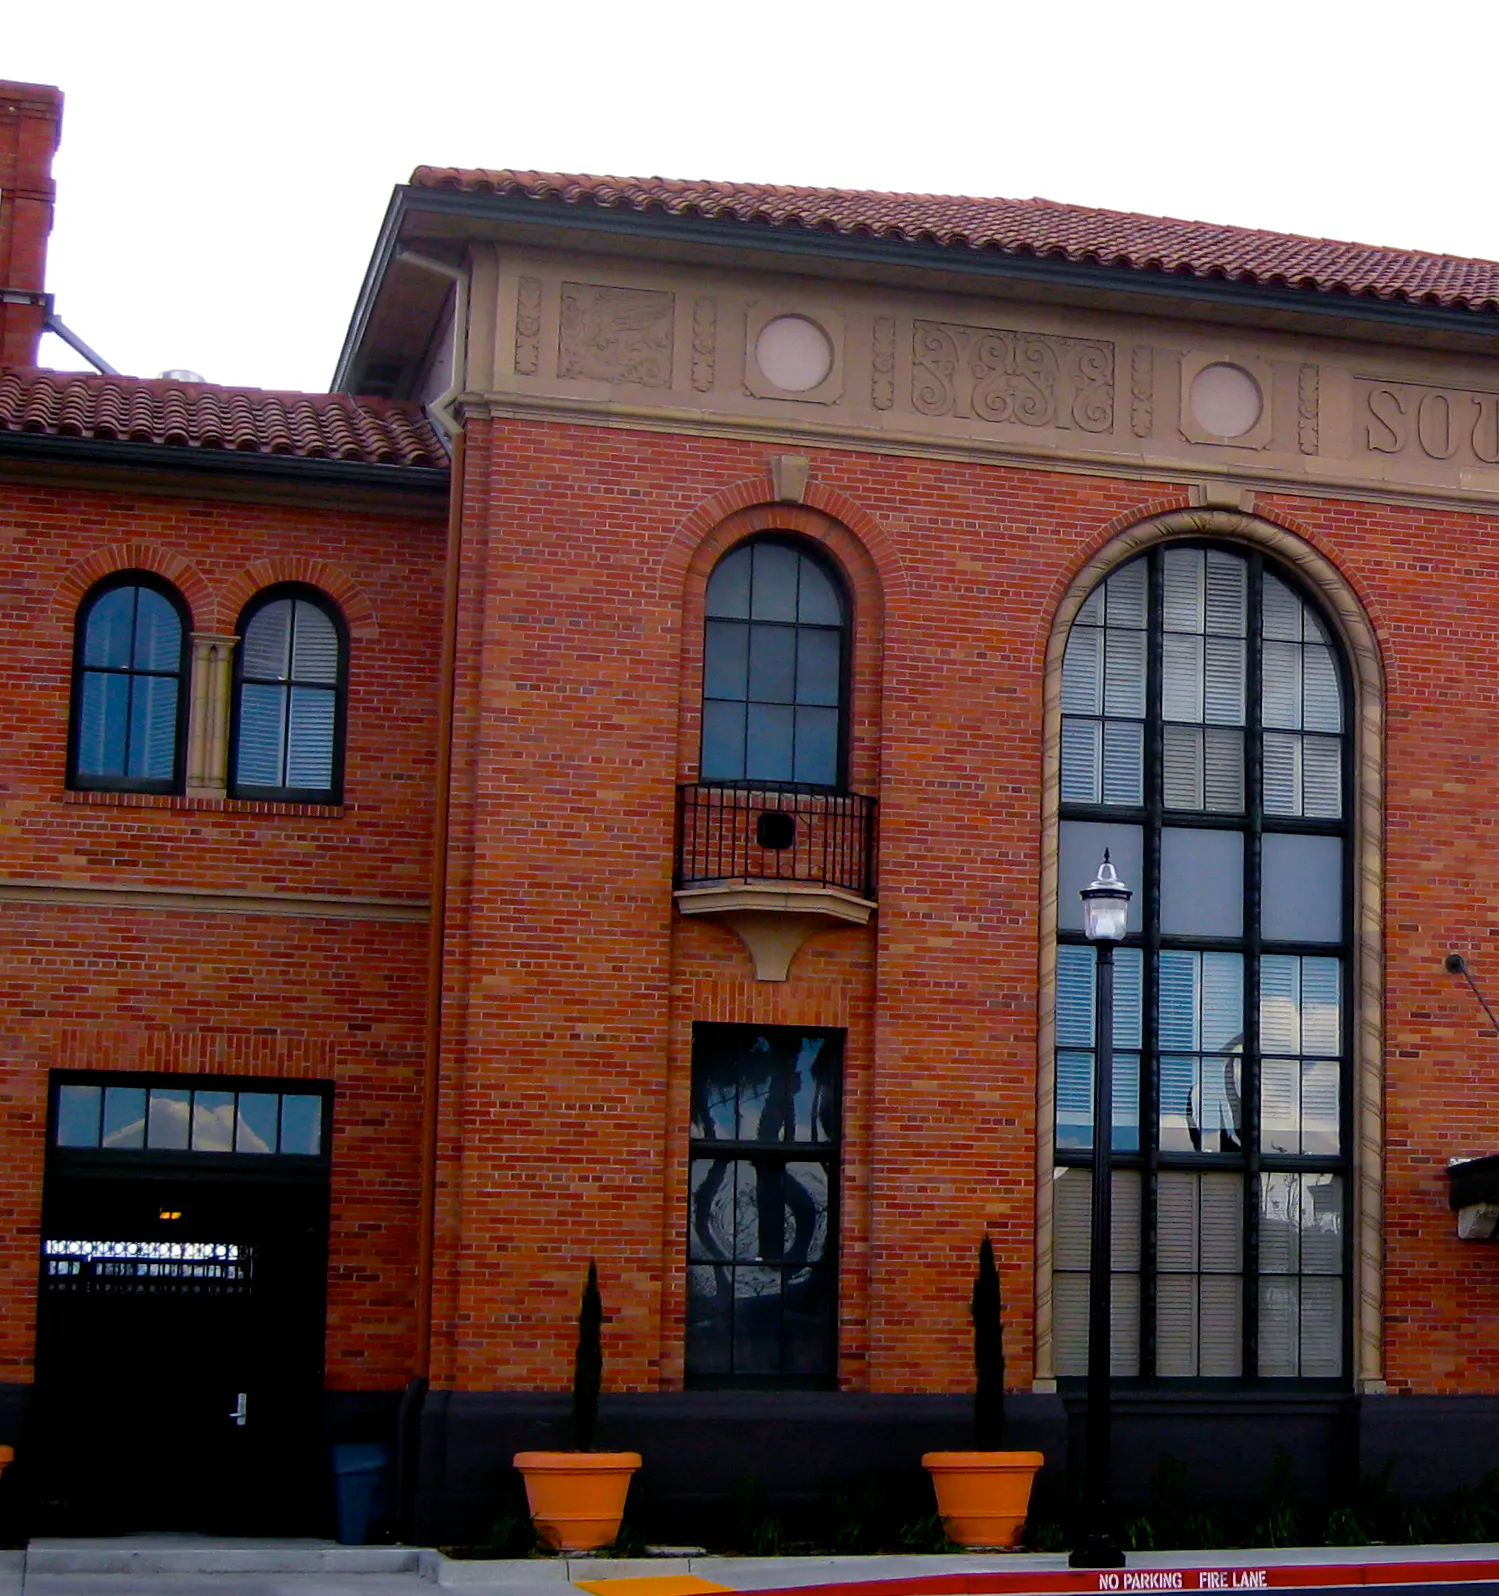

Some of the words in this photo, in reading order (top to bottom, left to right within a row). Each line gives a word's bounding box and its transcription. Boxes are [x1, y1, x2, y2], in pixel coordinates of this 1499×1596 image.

[1098, 1573, 1119, 1590] NO
[1123, 1571, 1183, 1590] PARKING
[1199, 1571, 1229, 1588] FIRE
[1232, 1570, 1268, 1588] LANE
